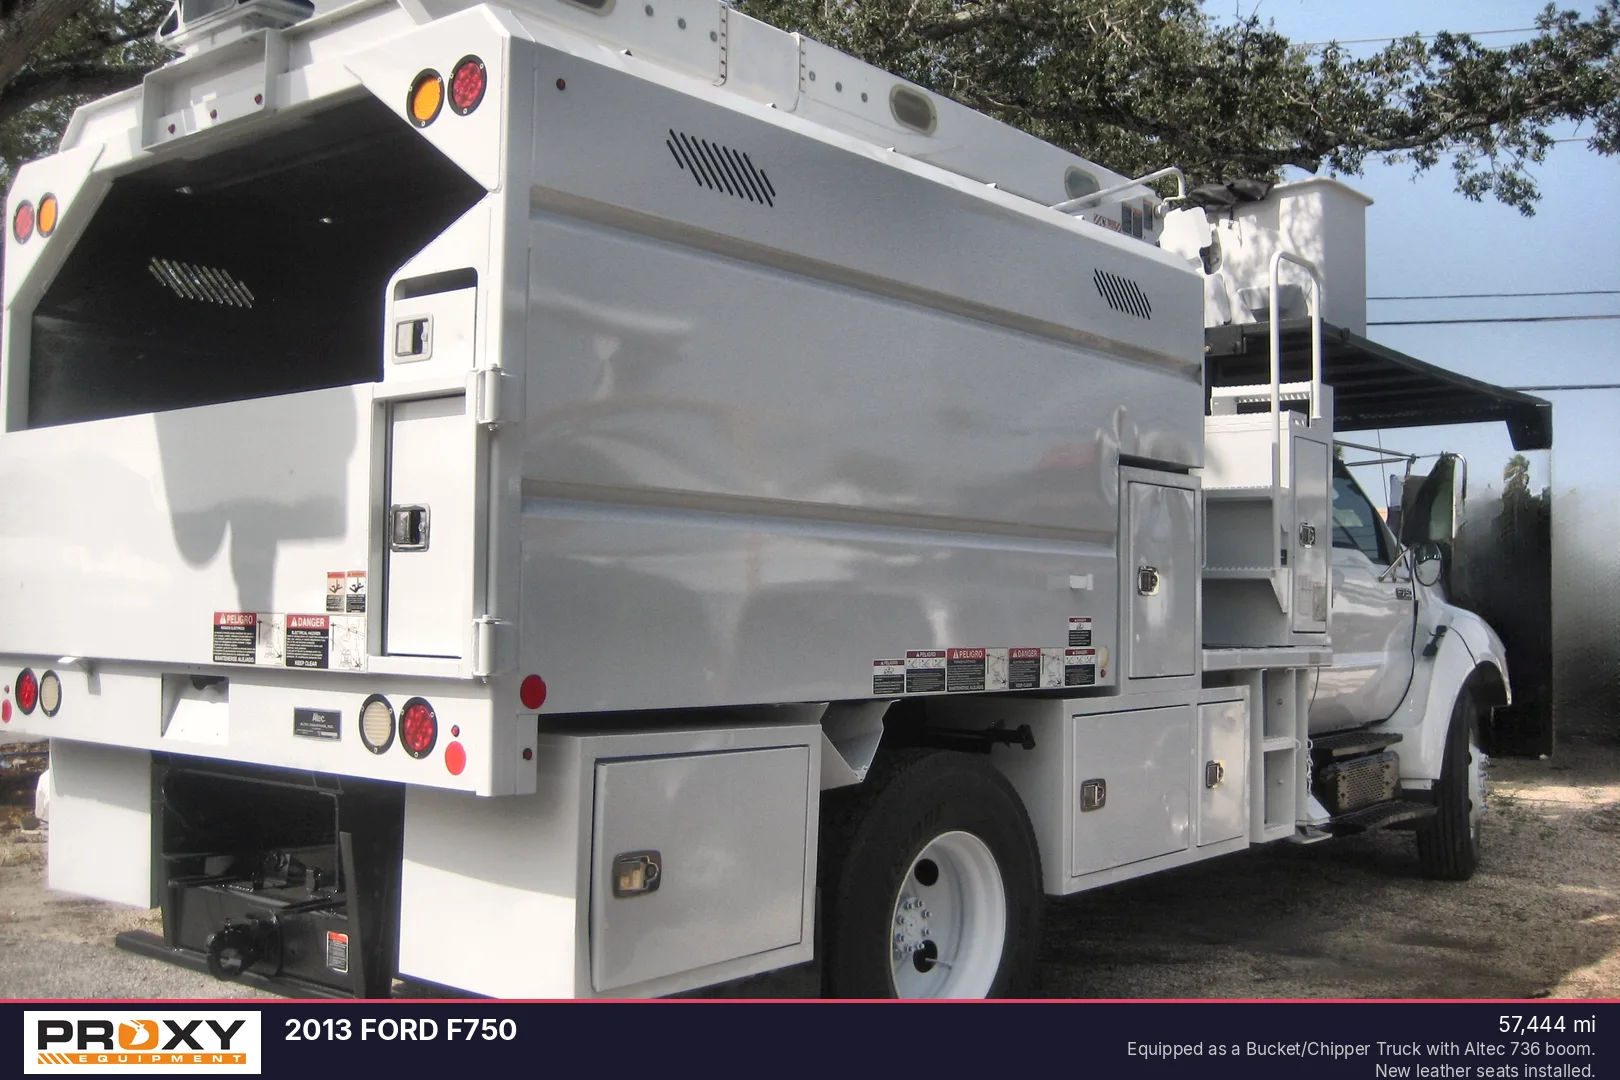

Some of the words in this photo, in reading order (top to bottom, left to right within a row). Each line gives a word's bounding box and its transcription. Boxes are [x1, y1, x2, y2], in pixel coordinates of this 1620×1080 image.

[226, 614, 254, 625] PELIGRO
[297, 617, 325, 627] DANGER
[959, 649, 983, 659] PELIGRO
[1017, 649, 1038, 658] DANGER
